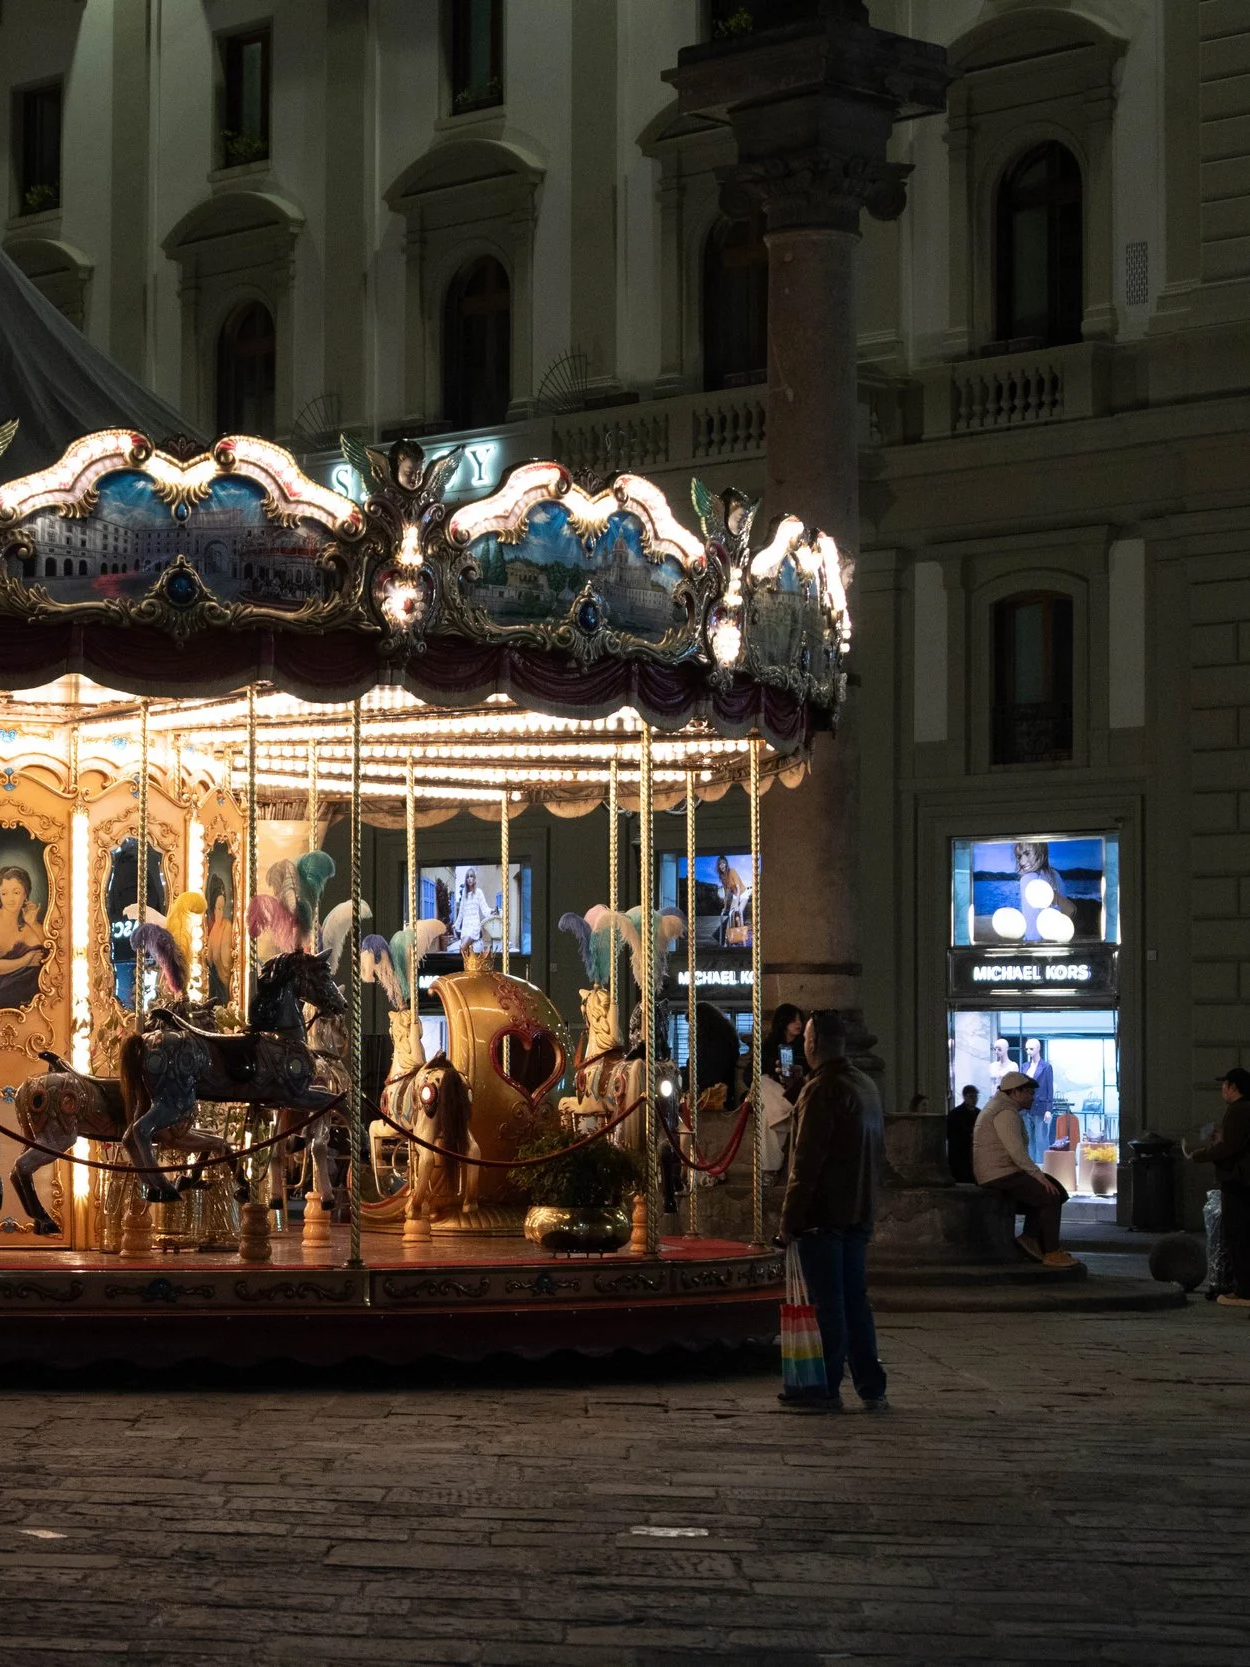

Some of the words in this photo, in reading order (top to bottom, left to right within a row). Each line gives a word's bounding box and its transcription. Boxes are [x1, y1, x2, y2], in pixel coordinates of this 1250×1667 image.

[678, 970, 738, 985] MCHAEL
[973, 965, 1042, 981] MICHAEL
[1045, 964, 1091, 981] KORS
